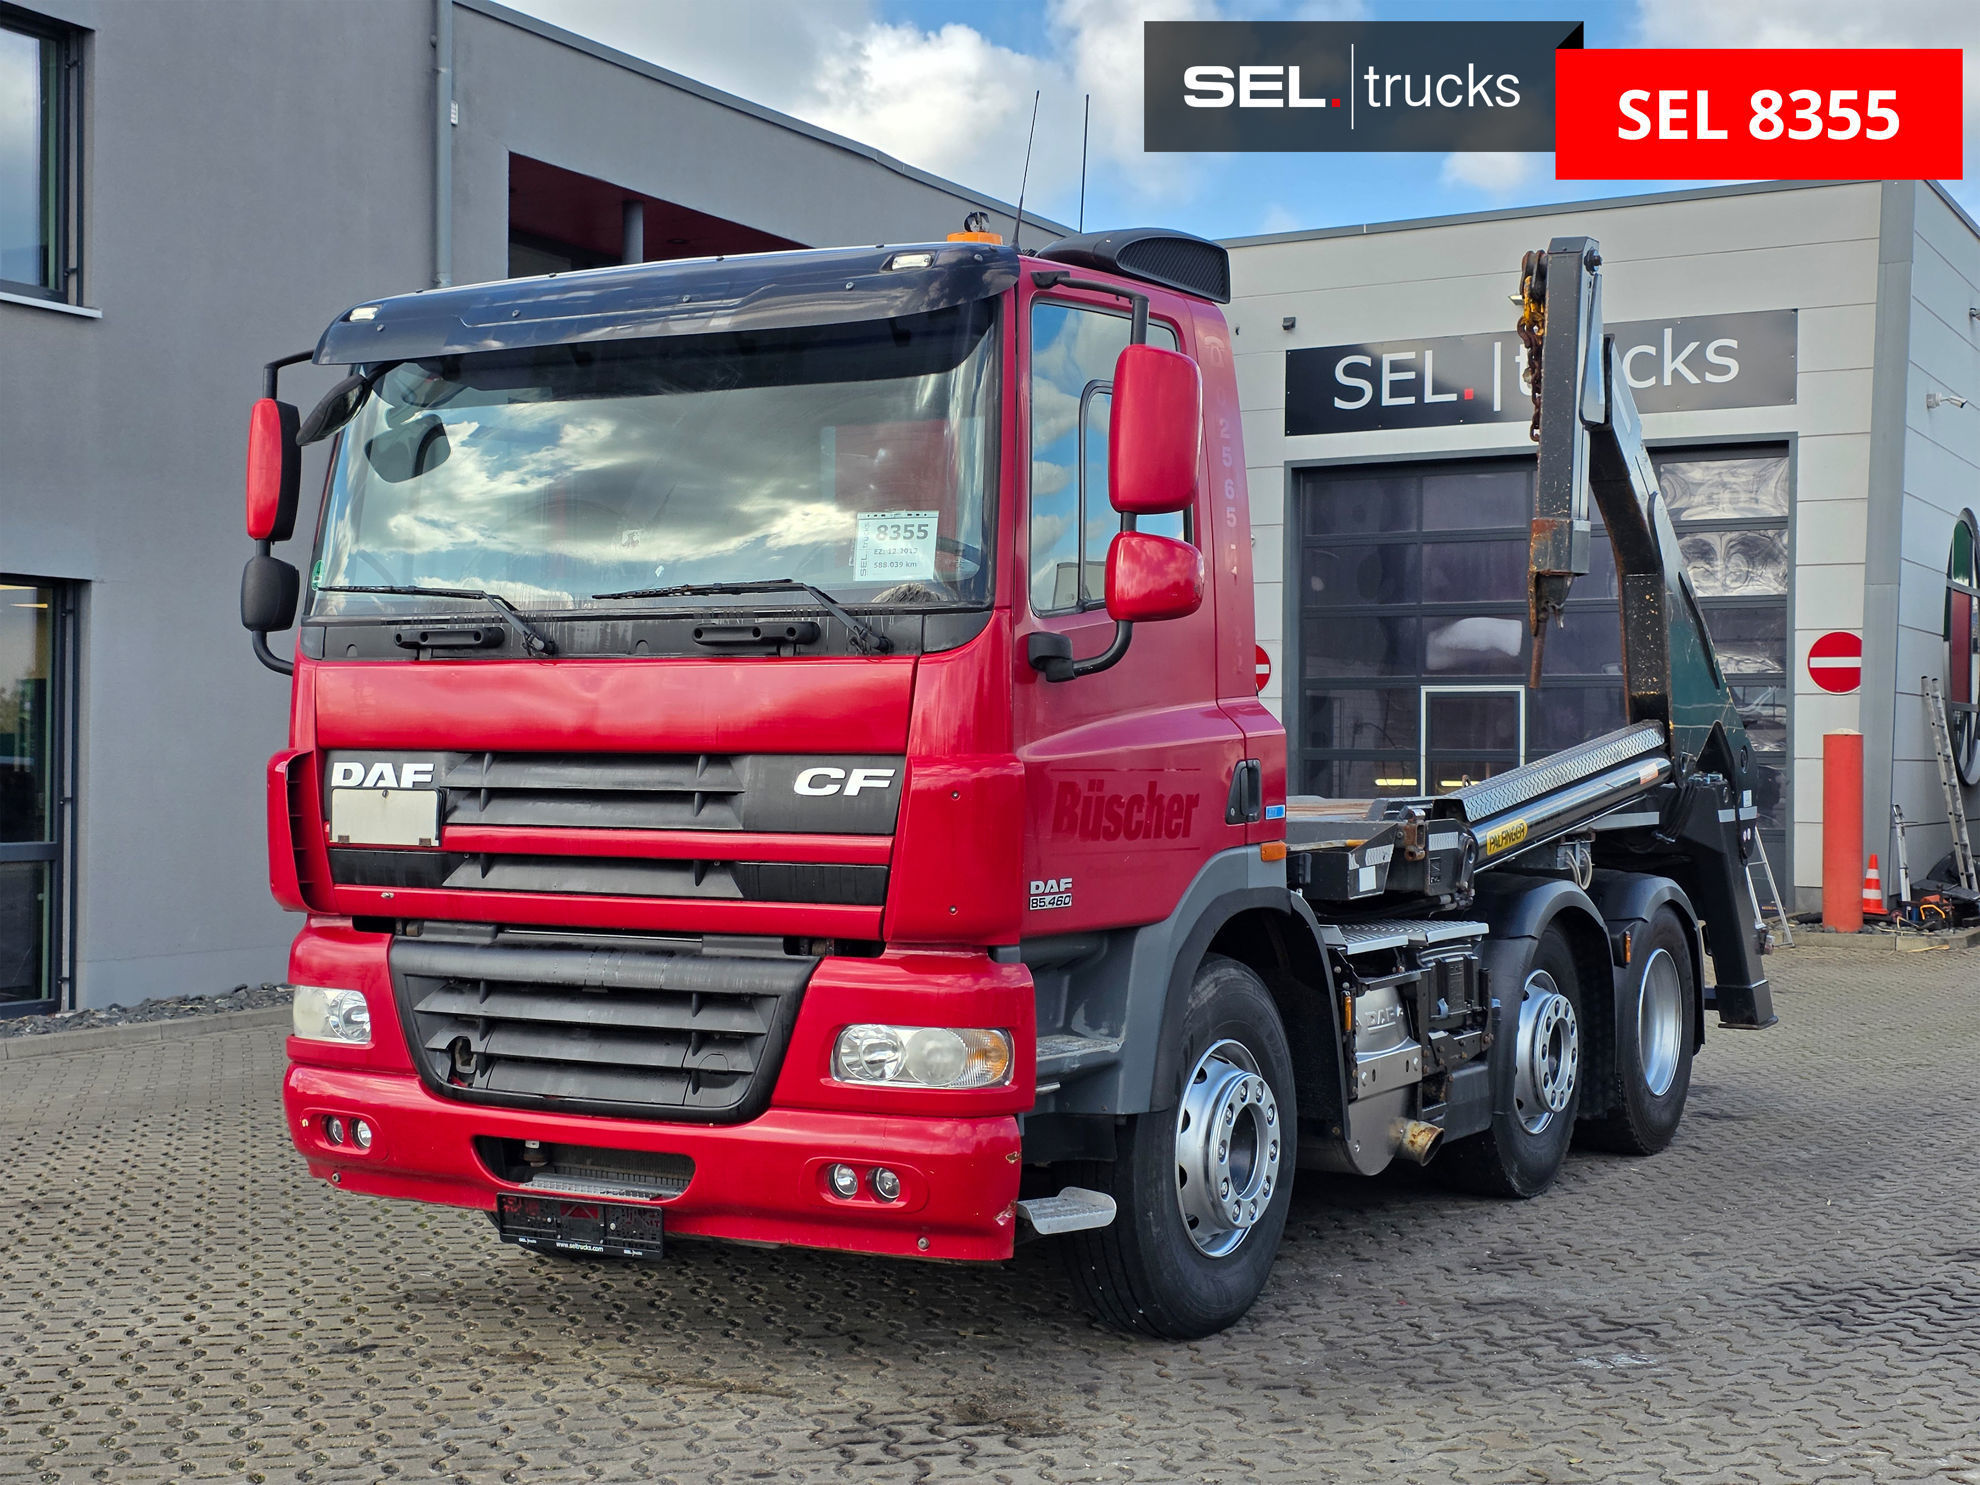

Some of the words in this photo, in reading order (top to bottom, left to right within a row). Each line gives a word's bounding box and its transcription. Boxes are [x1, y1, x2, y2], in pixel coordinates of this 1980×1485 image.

[1333, 349, 1474, 411] SEL.
[1514, 327, 1740, 397] tcks
[876, 524, 929, 541] 8355
[331, 762, 434, 787] DAF
[793, 767, 895, 797] CF
[1051, 779, 1200, 842] Büscher
[1030, 878, 1072, 894] DAF
[1030, 894, 1072, 910] 85.460
[556, 1242, 604, 1251] www.seltrucks.com
